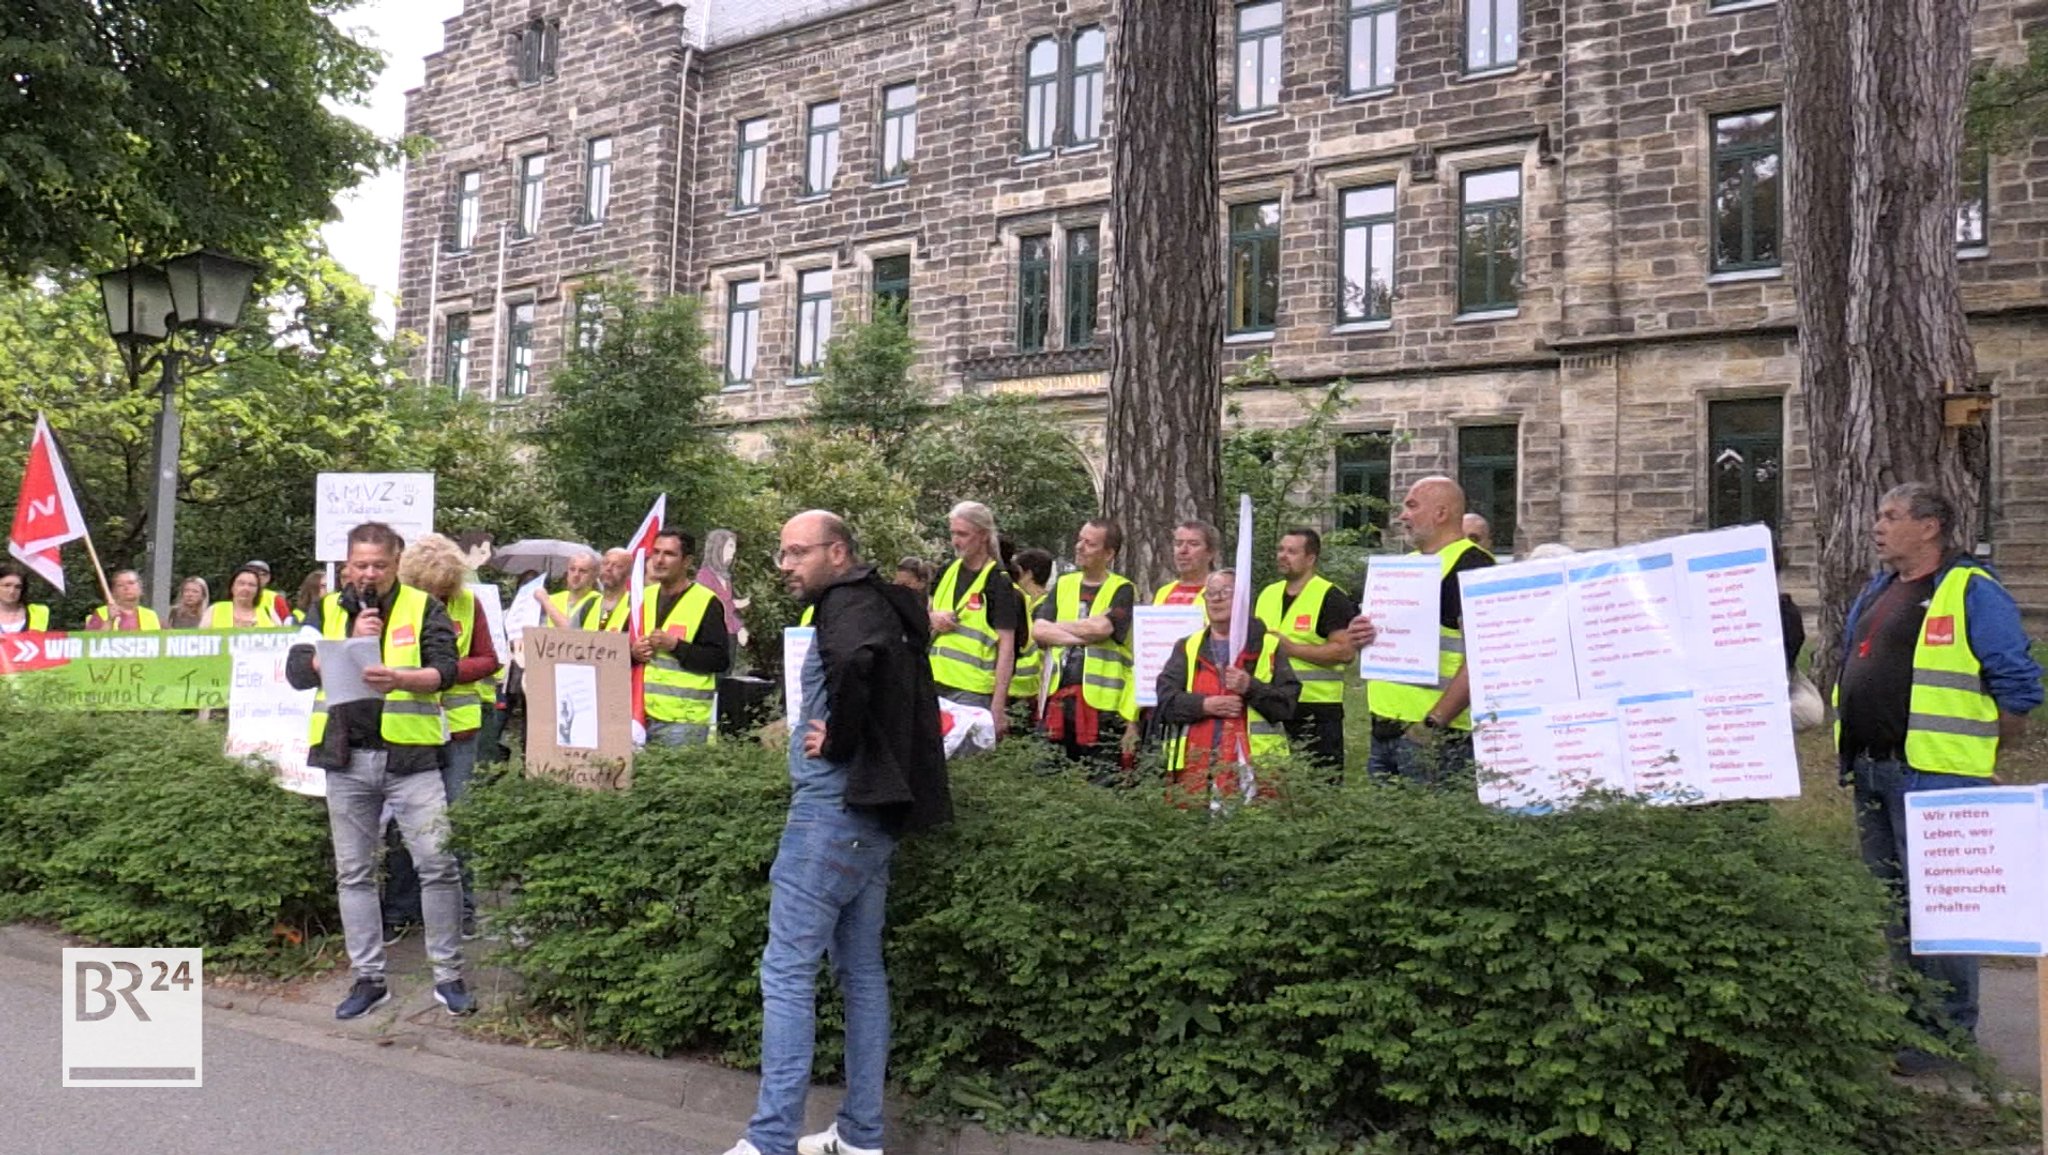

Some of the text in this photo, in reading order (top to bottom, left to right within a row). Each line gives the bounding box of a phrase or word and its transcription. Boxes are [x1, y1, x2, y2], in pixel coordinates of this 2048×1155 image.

[44, 637, 83, 658] WIR
[89, 636, 160, 658] LASSEN
[166, 635, 222, 657] NICHT
[535, 633, 617, 660] Verraten
[87, 663, 146, 685] WIR
[1922, 808, 1989, 821] Wir retten
[1923, 828, 1993, 840] Leben, wer
[1924, 845, 1995, 857] rettet uns?
[1924, 865, 2003, 877] Kommunale
[1925, 883, 2006, 896] Trägerschaft
[1925, 901, 1981, 912] erhalten
